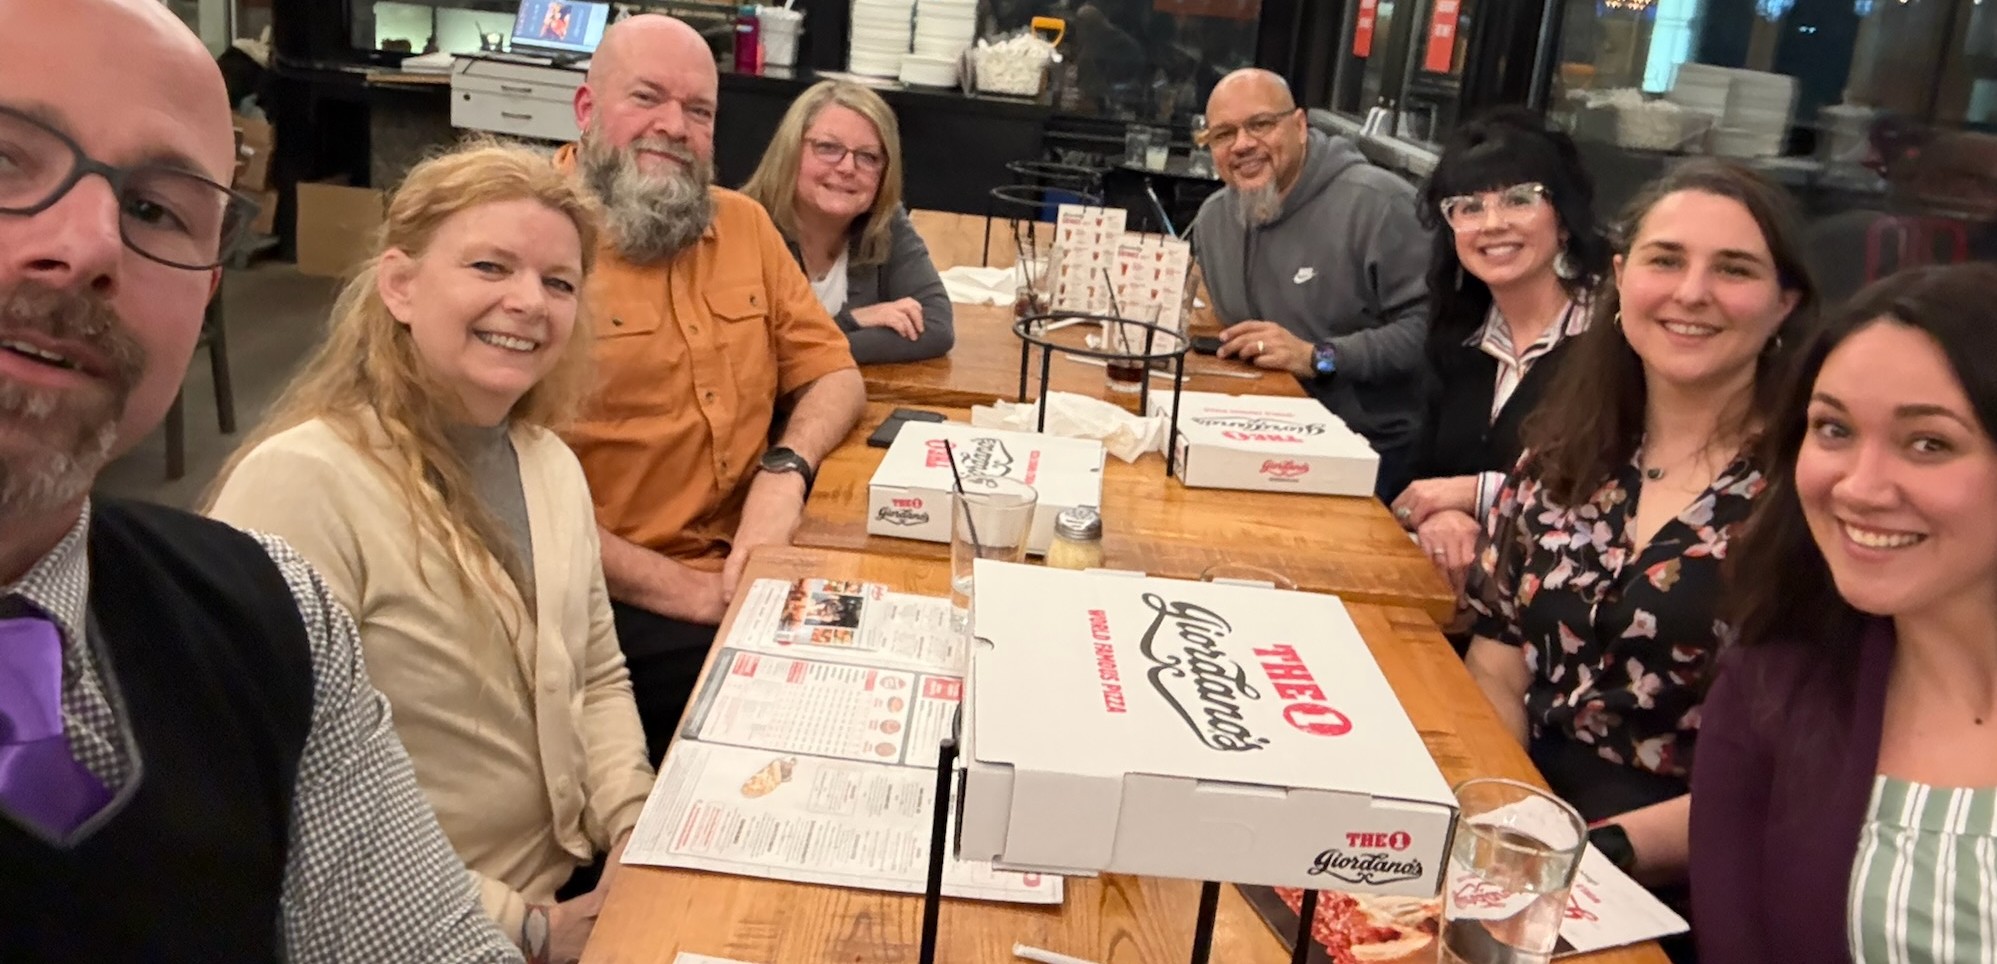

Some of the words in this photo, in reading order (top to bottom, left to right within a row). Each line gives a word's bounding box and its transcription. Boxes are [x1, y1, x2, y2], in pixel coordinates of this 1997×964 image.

[1086, 609, 1112, 642] WORLD
[1092, 642, 1121, 682] FAMOUS
[1139, 592, 1271, 752] Giordano's
[1252, 643, 1329, 702] THE
[1100, 682, 1128, 714] PIZZA
[1345, 832, 1389, 849] THE
[1307, 848, 1424, 886] Giordano's
